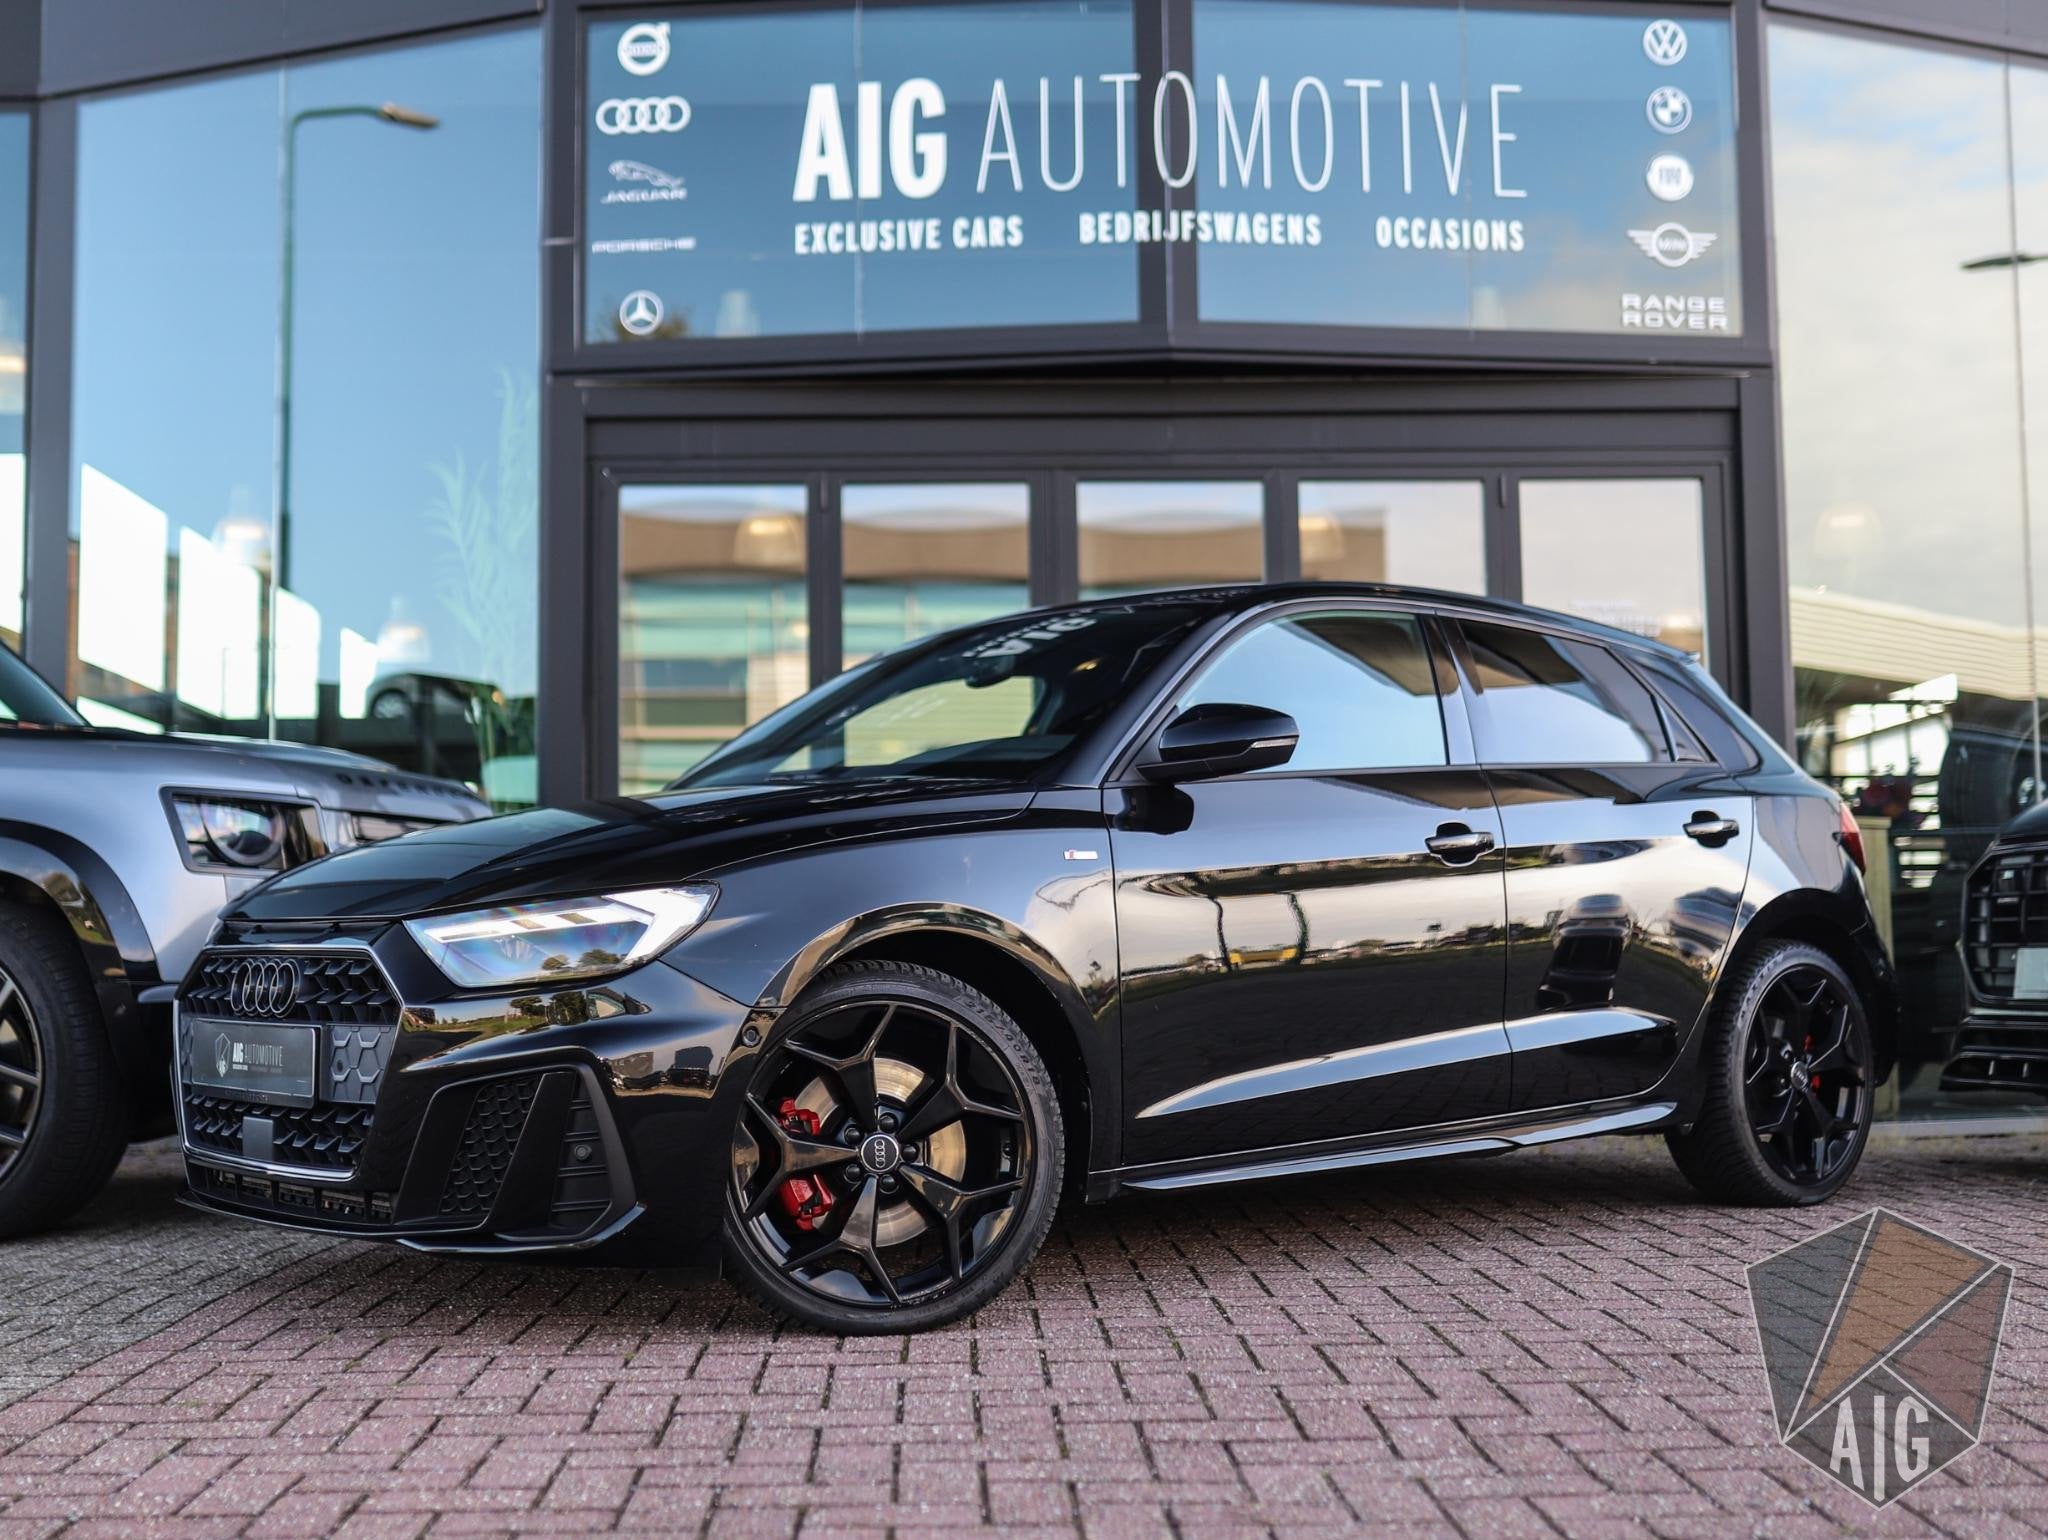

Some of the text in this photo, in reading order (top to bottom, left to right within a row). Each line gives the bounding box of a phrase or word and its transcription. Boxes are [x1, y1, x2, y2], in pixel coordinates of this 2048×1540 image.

[793, 71, 1527, 201] AIG AUTOMOTIVE
[794, 210, 1525, 255] EXCLUSIVE CARS BEDRIJFSWAGENS OCCASIONS
[1621, 293, 1727, 313] RANGE
[1621, 310, 1728, 331] ROVER
